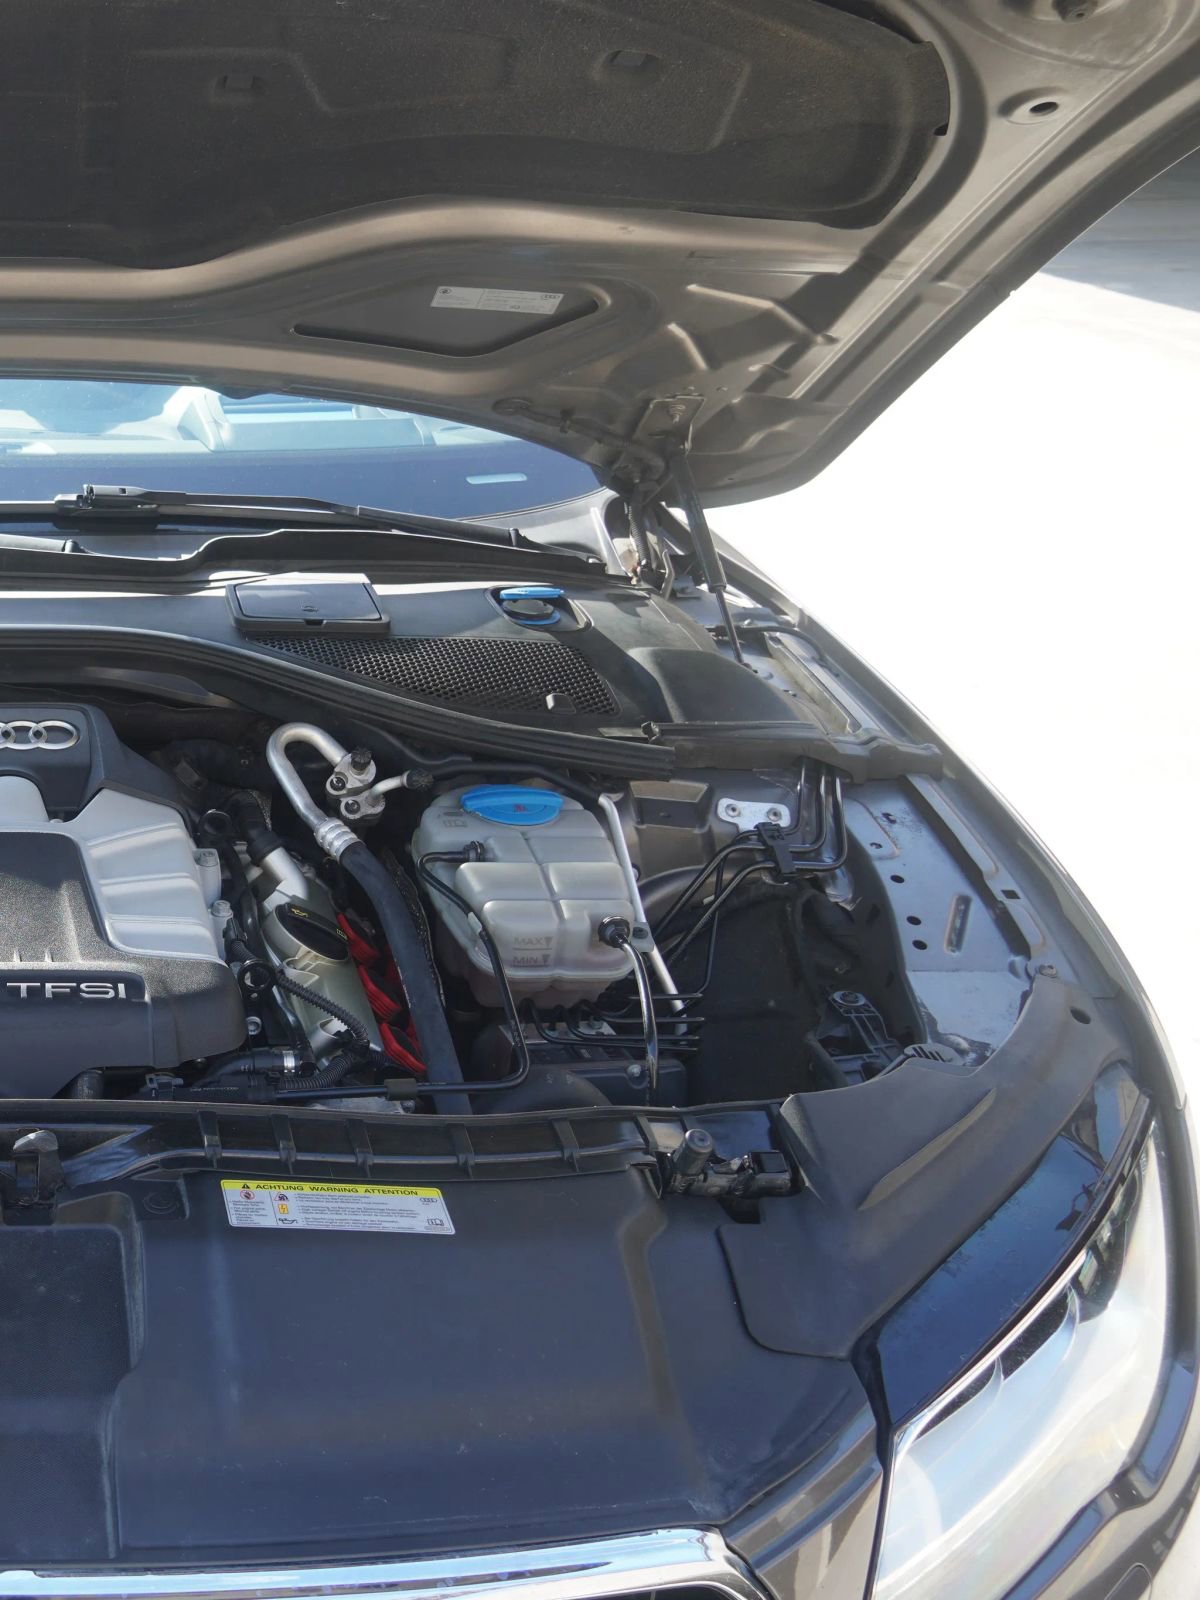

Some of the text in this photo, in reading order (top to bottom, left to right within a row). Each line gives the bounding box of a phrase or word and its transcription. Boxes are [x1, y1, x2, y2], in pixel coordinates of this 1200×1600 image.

[513, 936, 544, 945] MAX
[512, 955, 539, 965] MIN
[6, 982, 127, 999] TFSI
[309, 1185, 359, 1193] WARNING
[364, 1188, 418, 1196] ATTENTION
